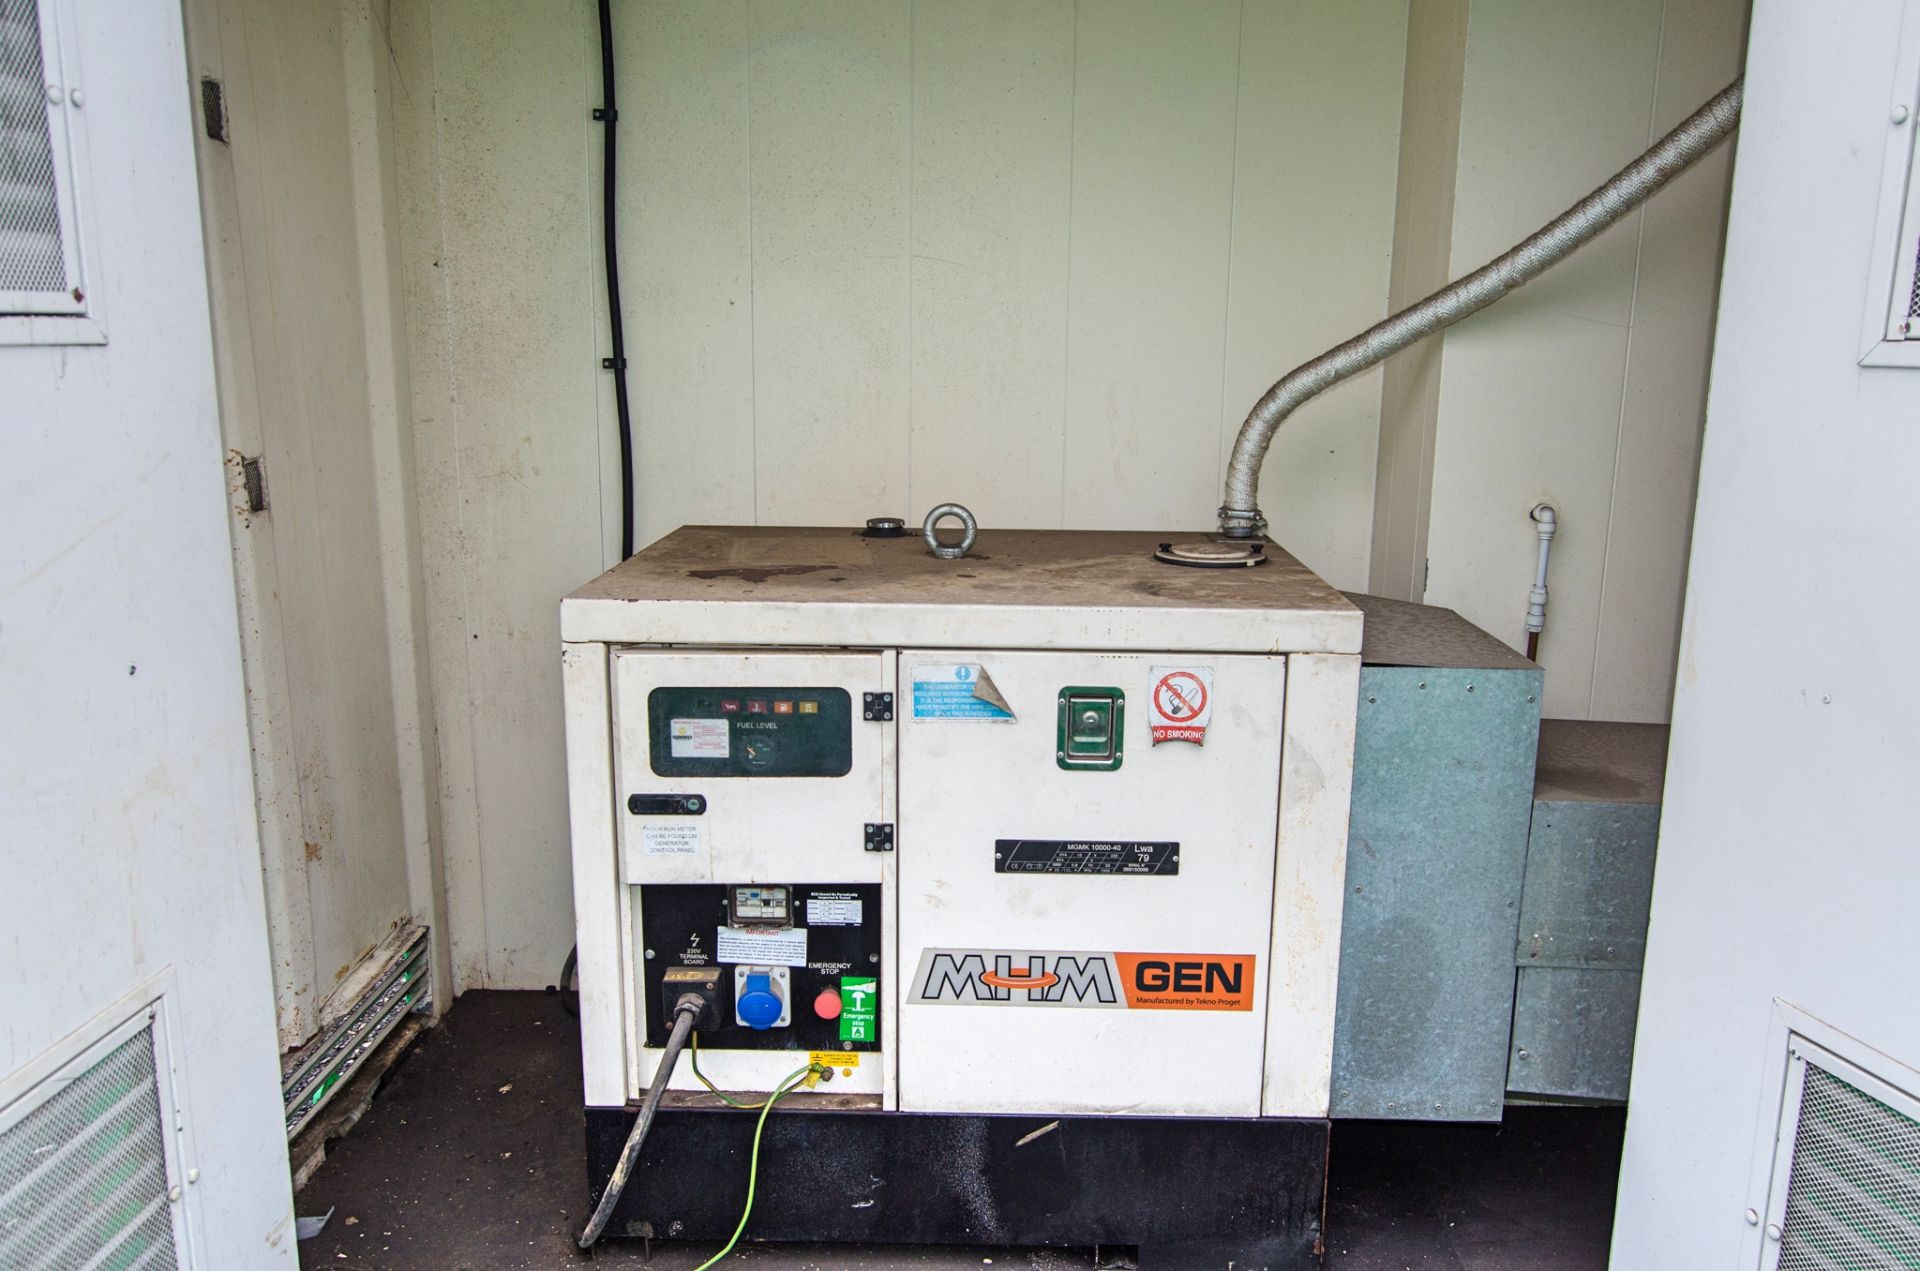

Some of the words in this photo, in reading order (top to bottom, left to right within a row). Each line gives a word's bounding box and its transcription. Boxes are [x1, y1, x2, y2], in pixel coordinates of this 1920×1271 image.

[1153, 730, 1166, 738] NO
[1167, 730, 1204, 739] SMOKING
[1134, 844, 1153, 852] Lwa
[1138, 853, 1150, 862] 79
[921, 952, 1118, 1003] MHM
[1136, 960, 1243, 994] GEN
[1136, 997, 1184, 1005] Manufactured
[1185, 998, 1194, 1006] by
[1218, 998, 1241, 1006] Proget
[843, 1012, 874, 1021] Emergency
